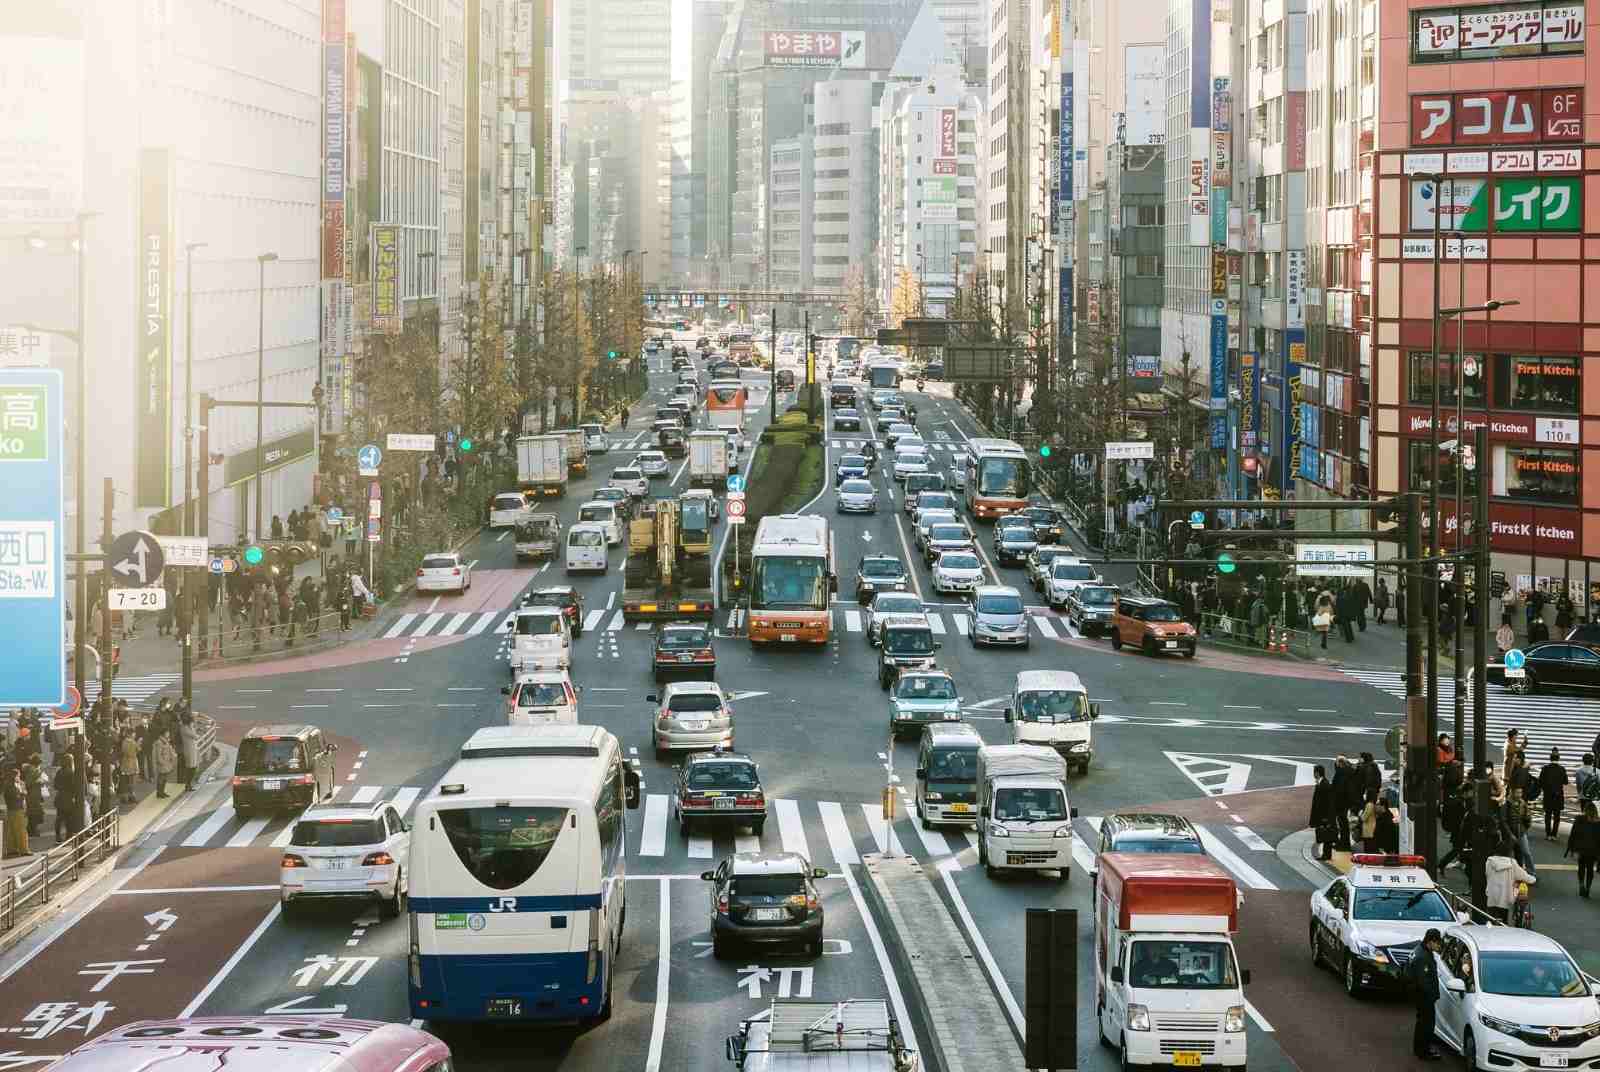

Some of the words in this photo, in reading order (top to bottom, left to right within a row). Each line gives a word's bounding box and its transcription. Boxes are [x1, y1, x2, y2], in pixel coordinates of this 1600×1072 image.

[769, 33, 836, 51] やまや
[1460, 18, 1582, 48] エーアイアール
[327, 70, 343, 114] JAPAN
[1552, 94, 1577, 113] 6F
[1421, 96, 1534, 139] アコム
[1562, 123, 1580, 136] 入口
[1496, 154, 1530, 168] アコム
[1541, 153, 1577, 168] アコム
[327, 157, 343, 193] CLUB
[1191, 160, 1203, 196] LABI
[1494, 186, 1571, 220] レイク
[1516, 363, 1540, 375] First
[3, 392, 39, 431] 高
[1491, 422, 1528, 434] Kitchen
[1516, 459, 1540, 471] First
[1492, 521, 1520, 535] First
[1521, 522, 1574, 540] Kitchen
[119, 593, 157, 605] 7-20
[489, 898, 518, 912] JR
[737, 965, 815, 999] 初
